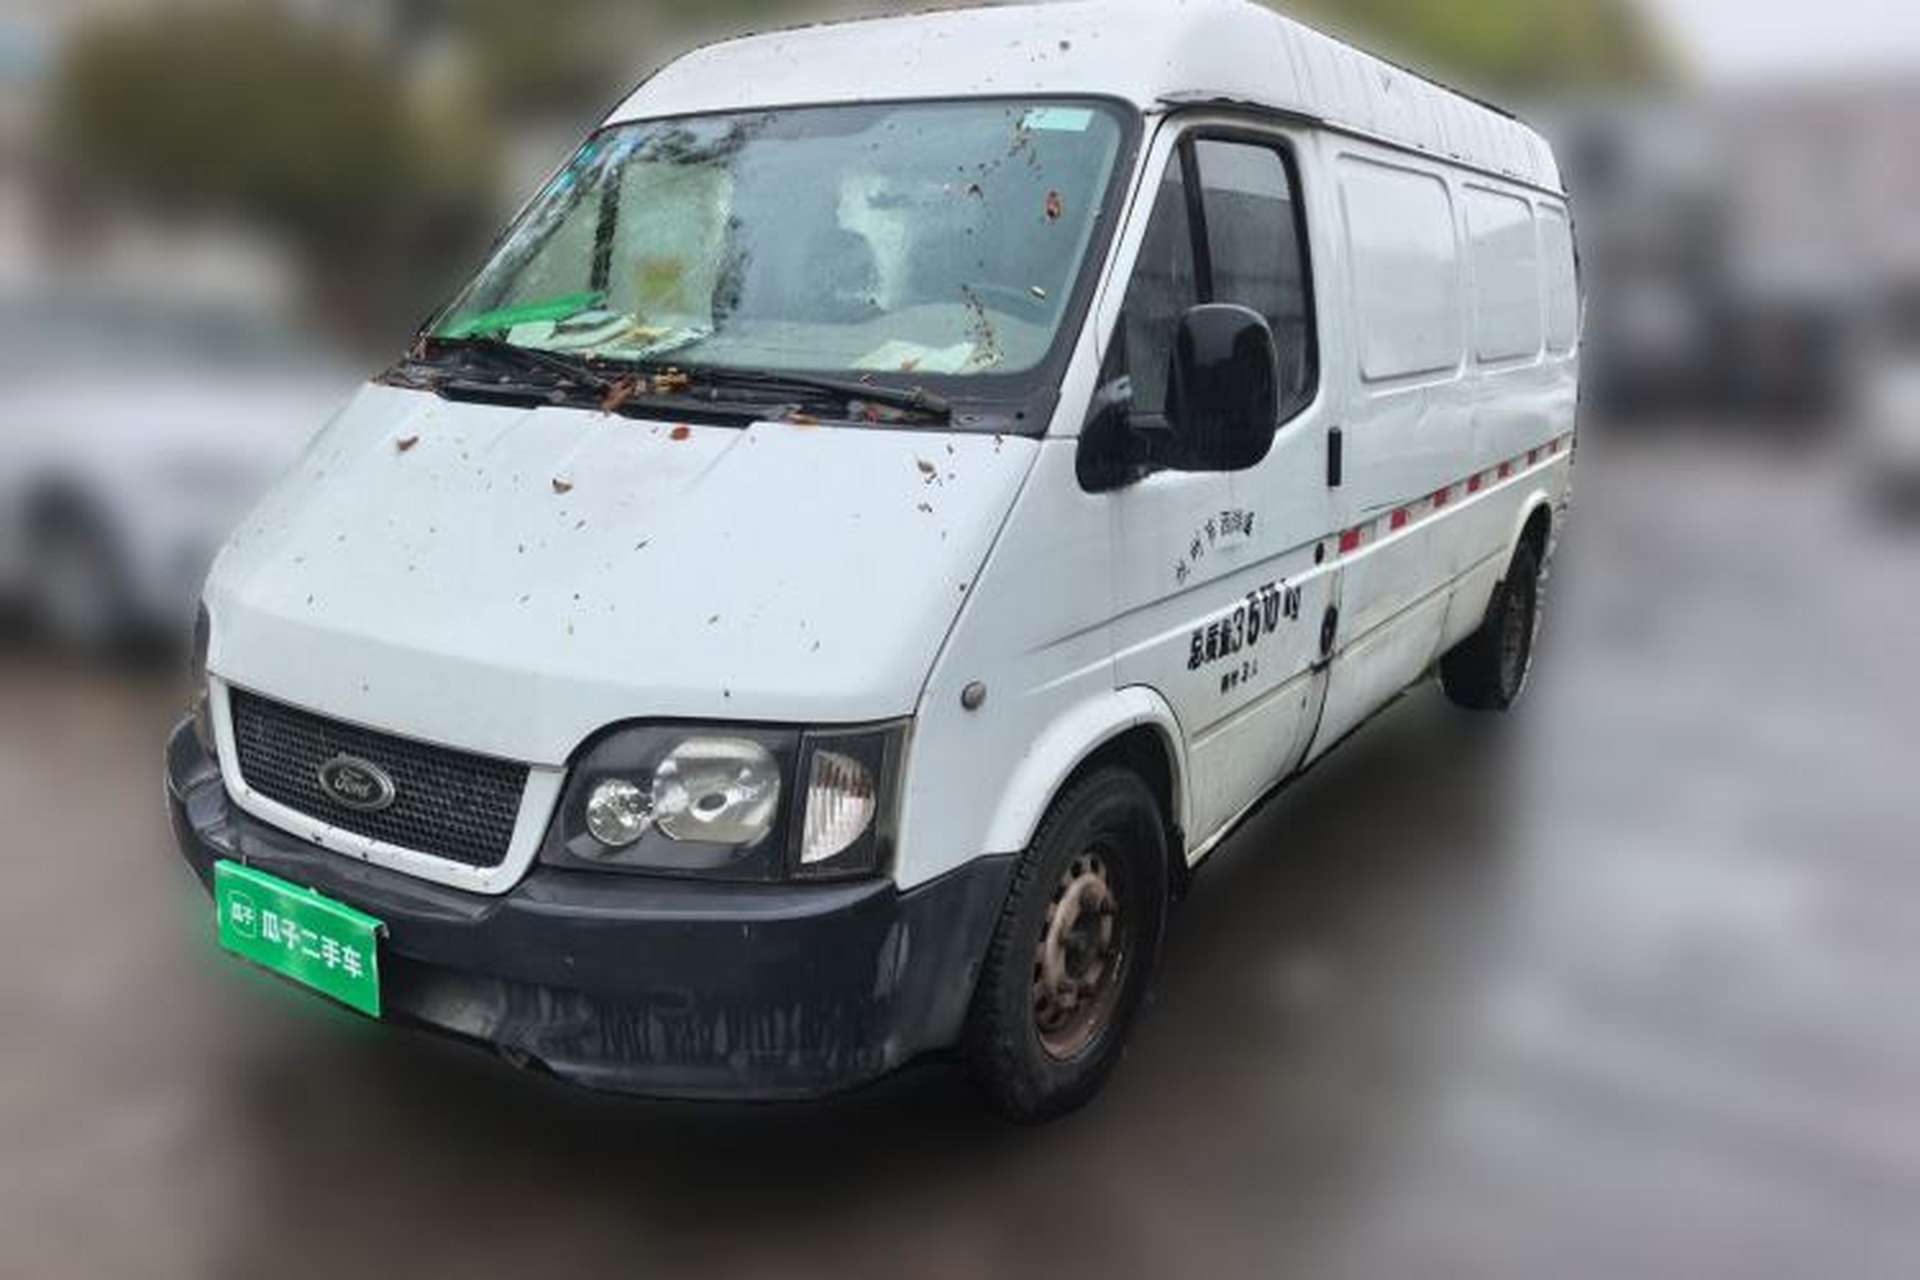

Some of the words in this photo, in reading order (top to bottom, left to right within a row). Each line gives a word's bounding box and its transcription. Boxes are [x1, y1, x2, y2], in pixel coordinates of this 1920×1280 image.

[262, 910, 363, 978] 瓜子二手车
